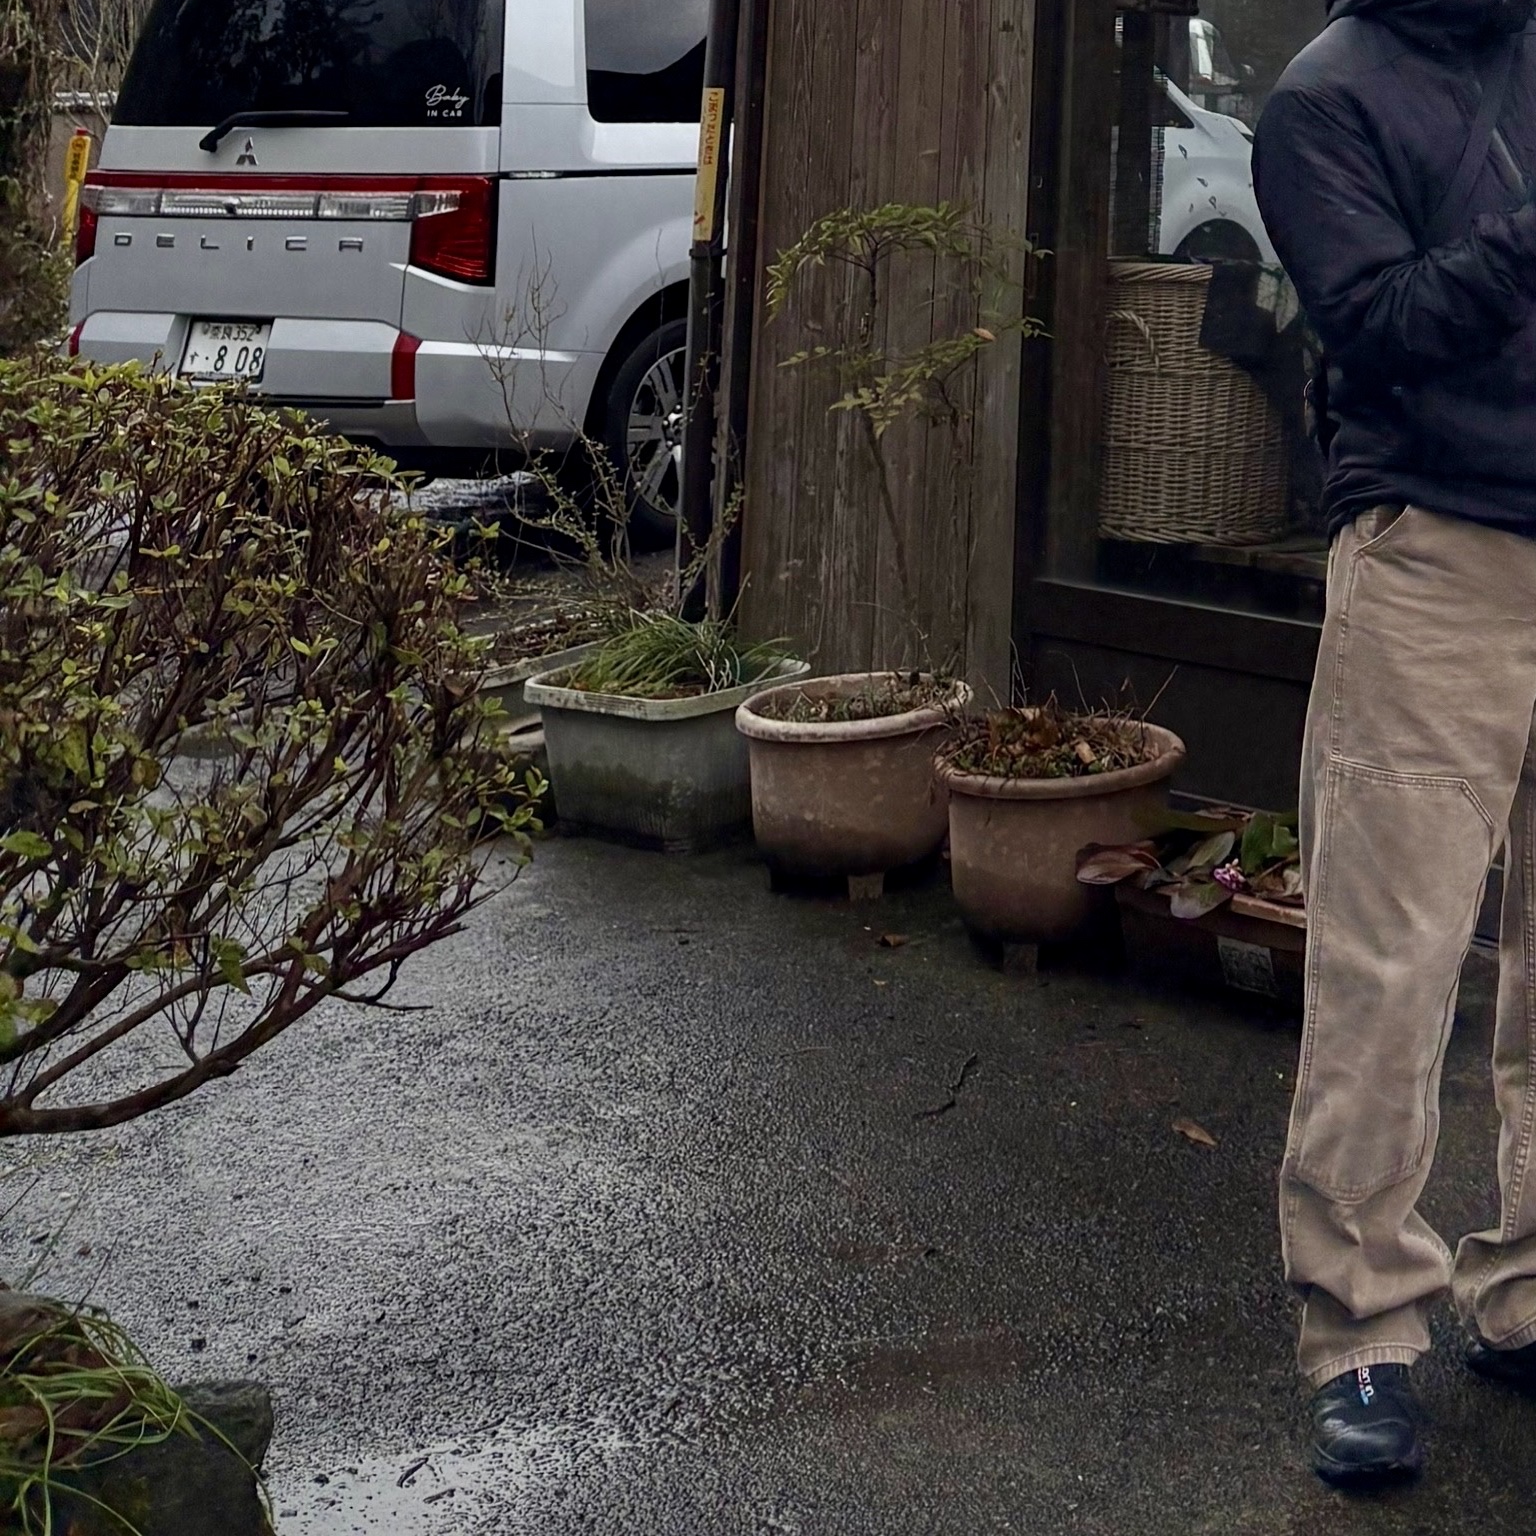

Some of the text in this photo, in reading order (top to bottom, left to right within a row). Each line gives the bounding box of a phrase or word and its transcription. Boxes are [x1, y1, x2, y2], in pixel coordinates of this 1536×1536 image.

[424, 83, 471, 109] Baby
[426, 109, 438, 117] IN
[113, 231, 364, 253] DELICA
